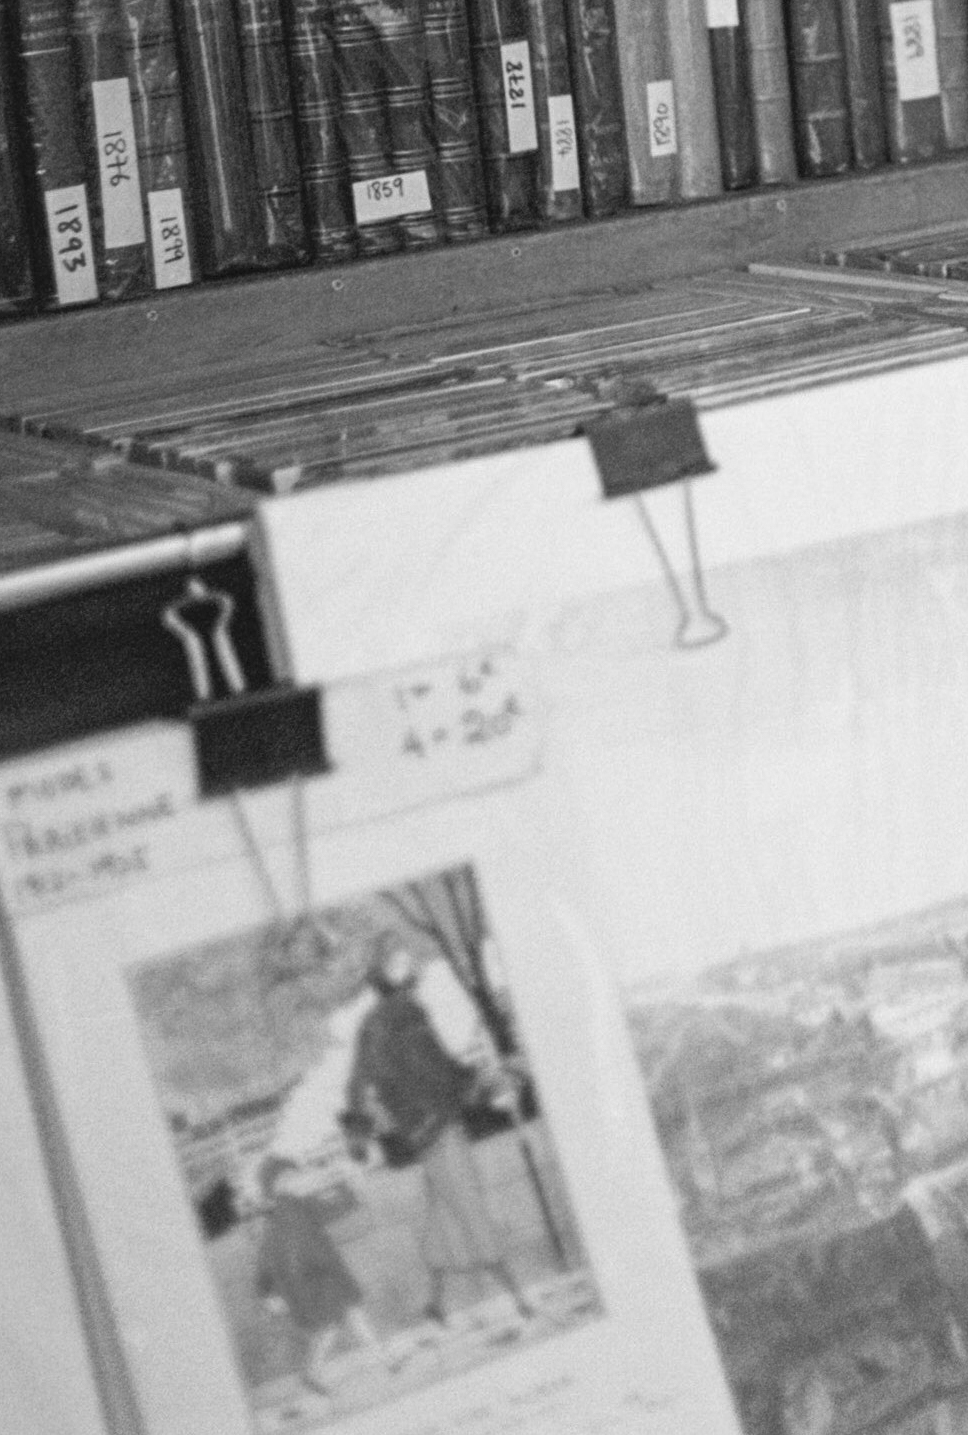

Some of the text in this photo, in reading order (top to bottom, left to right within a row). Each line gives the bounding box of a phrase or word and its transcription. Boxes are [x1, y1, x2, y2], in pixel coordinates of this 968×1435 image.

[102, 130, 129, 188] 1876
[366, 177, 404, 201] 1859
[54, 203, 88, 274] 1893
[160, 215, 185, 265] 1899
